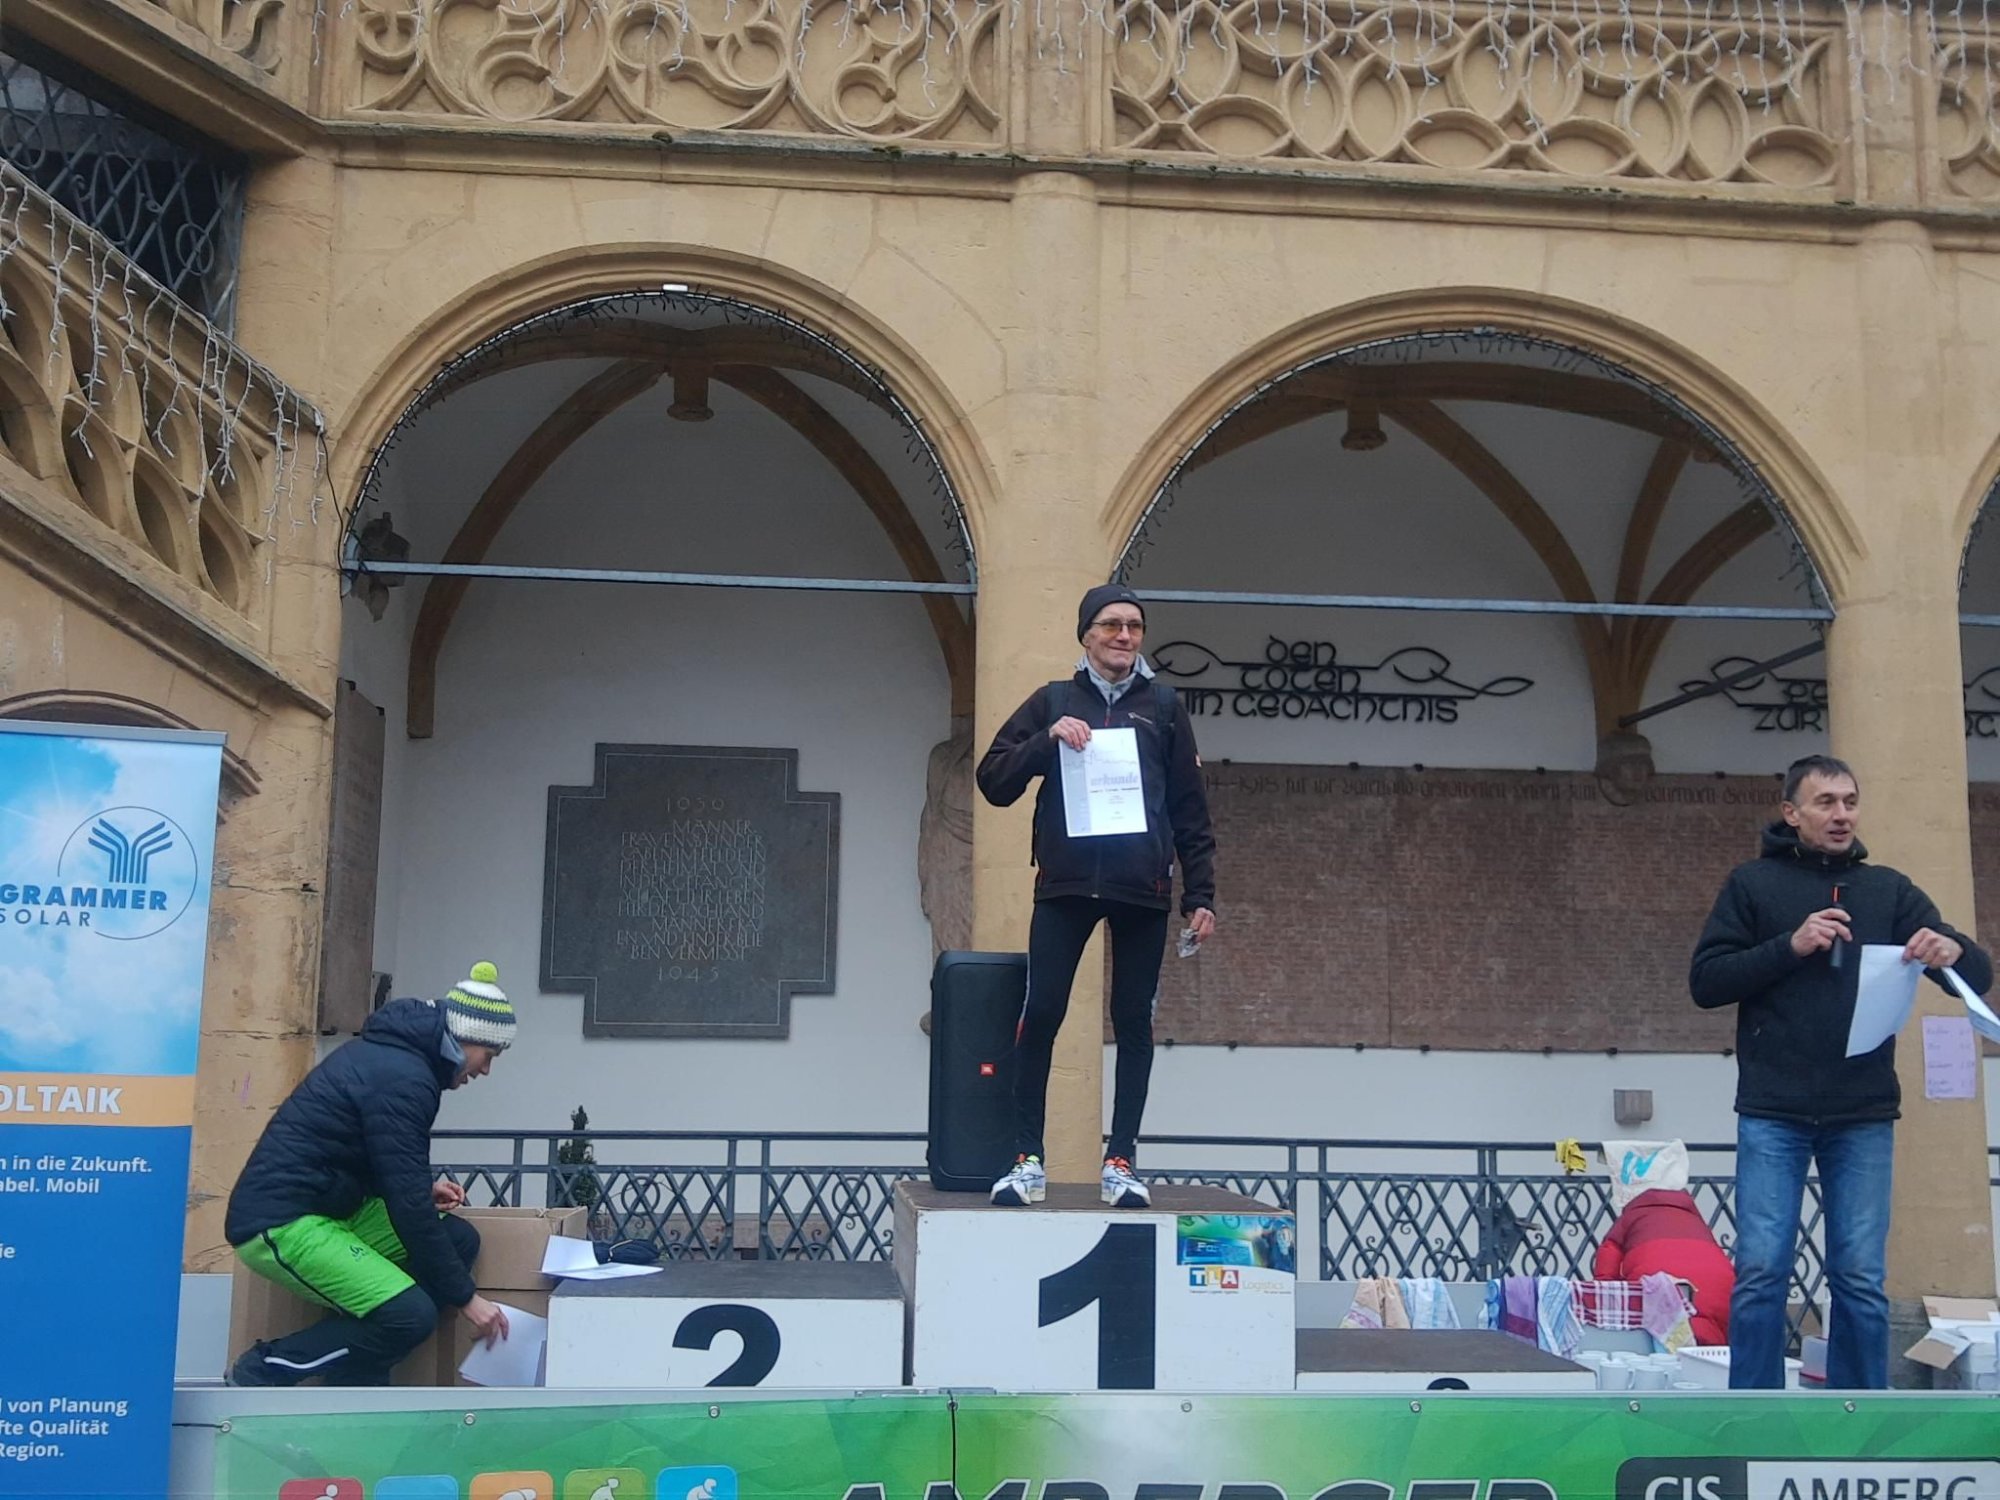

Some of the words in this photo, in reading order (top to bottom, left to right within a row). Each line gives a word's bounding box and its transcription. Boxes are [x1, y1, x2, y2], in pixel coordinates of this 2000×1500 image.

[0, 884, 168, 911] GRAMMER
[12, 1154, 31, 1171] in
[36, 1154, 66, 1171] die
[70, 1155, 153, 1173] Zukunft.
[46, 1177, 100, 1194] Mobil
[1038, 1223, 1156, 1389] 1
[673, 1304, 781, 1387] 2
[7, 1401, 43, 1414] von
[49, 1397, 128, 1417] Planung
[29, 1419, 110, 1439] Qualität
